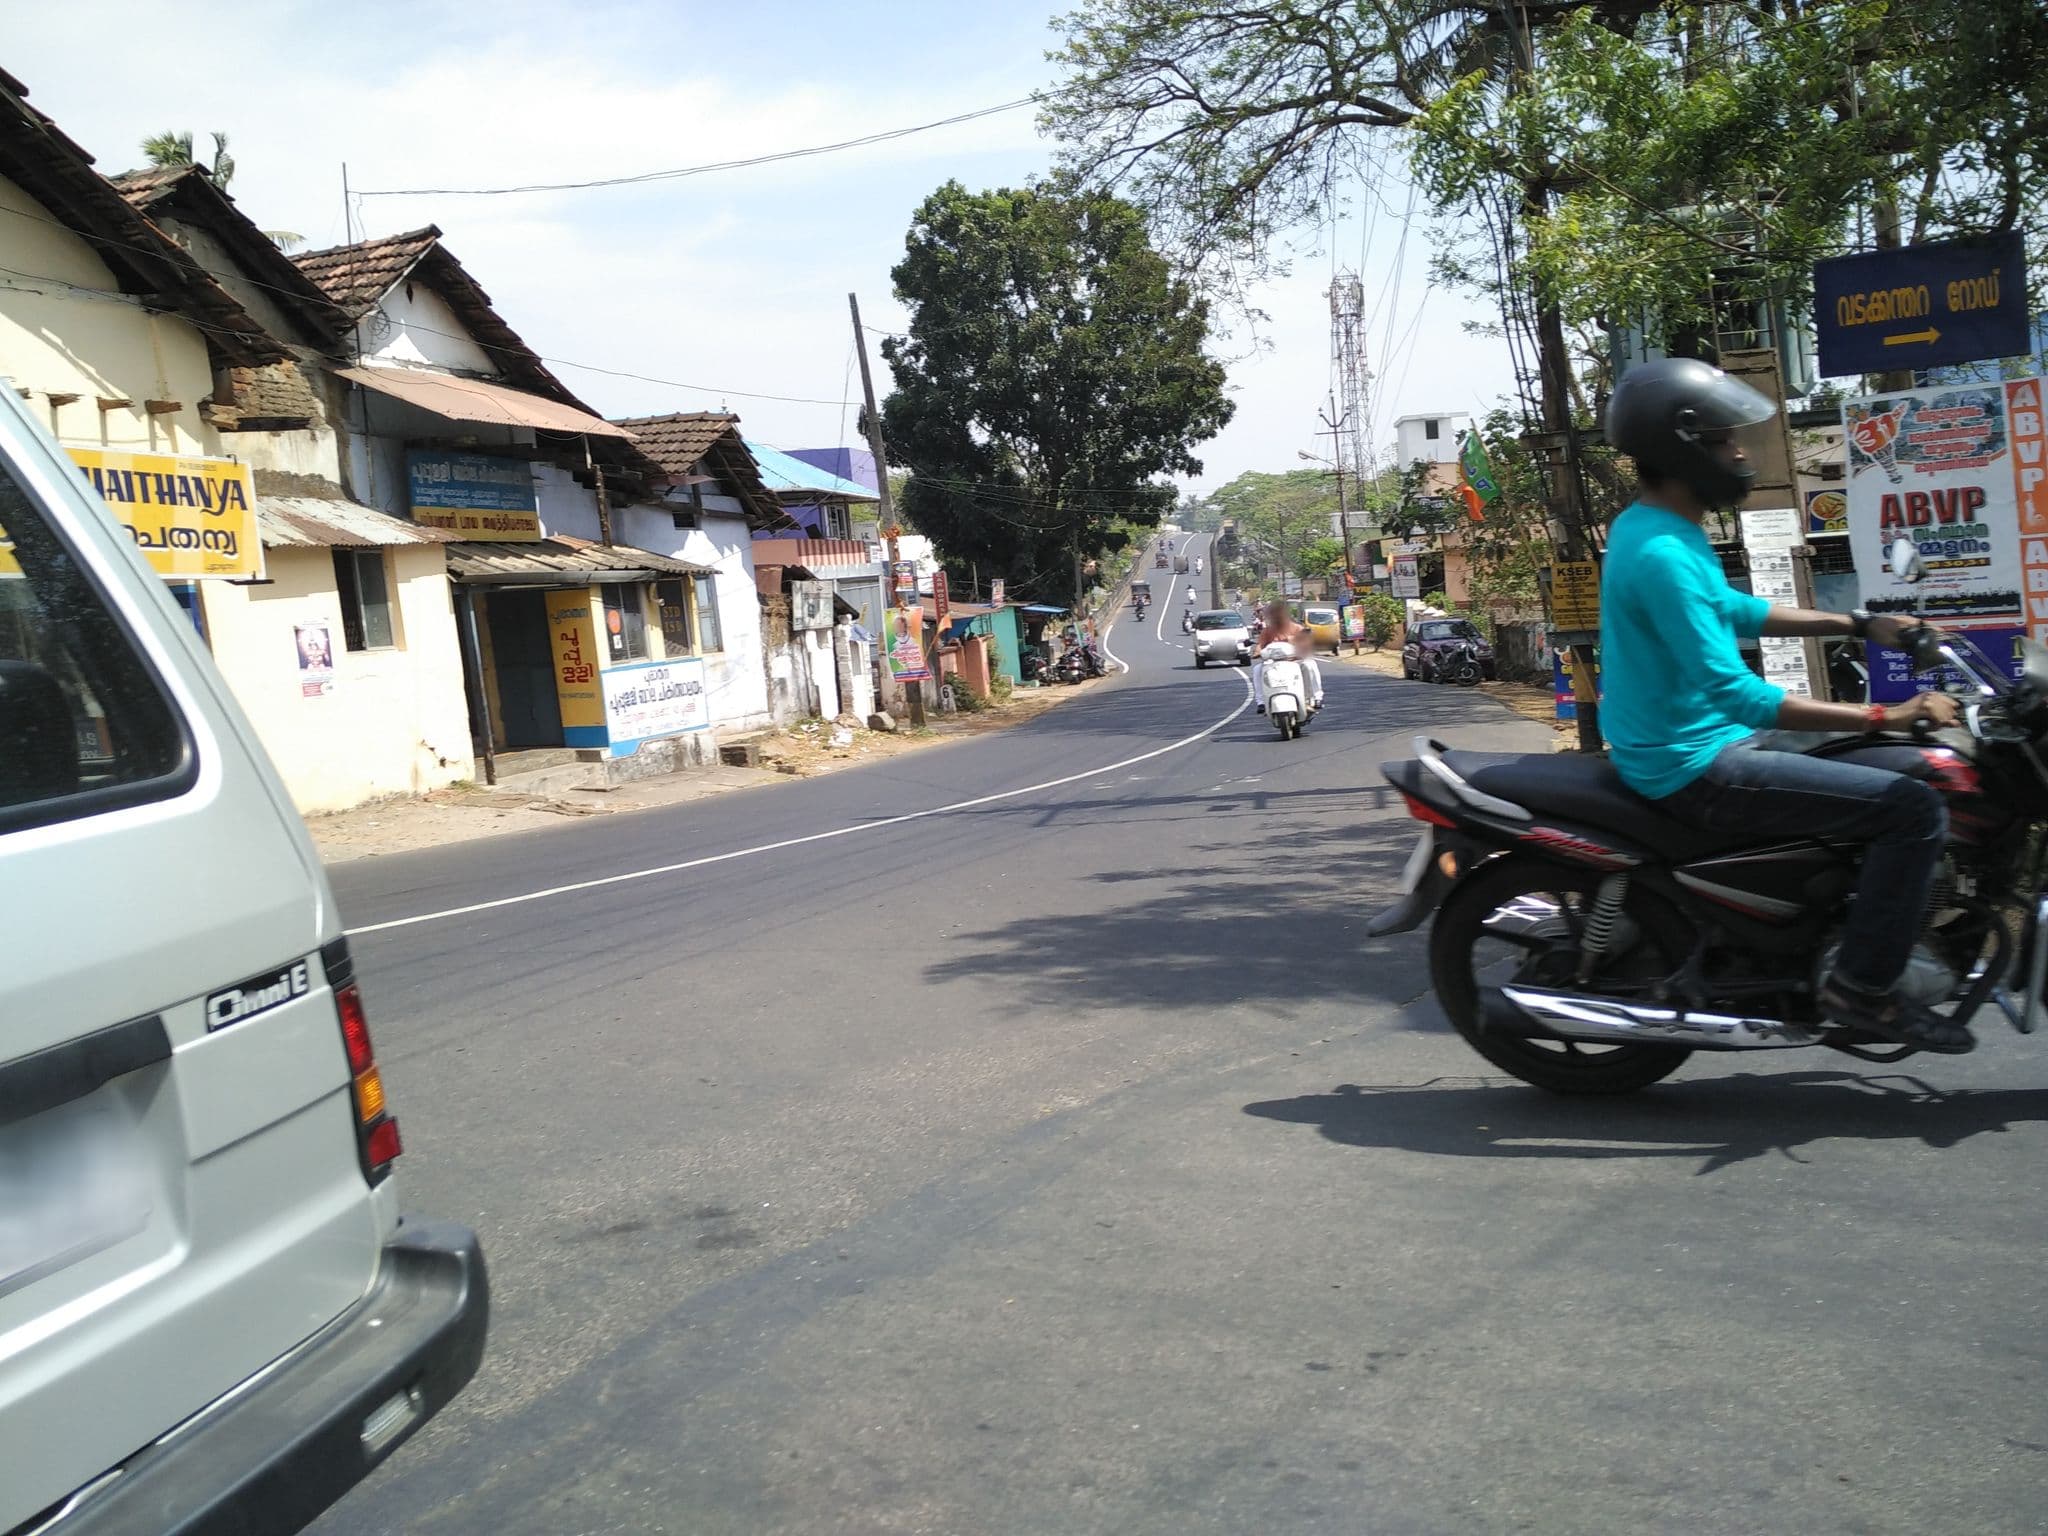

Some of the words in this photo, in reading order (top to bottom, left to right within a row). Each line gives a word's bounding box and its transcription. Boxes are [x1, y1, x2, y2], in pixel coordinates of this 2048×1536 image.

[78, 466, 248, 516] HAITHANYA
[1880, 486, 1986, 529] ABVP
[1556, 566, 1593, 577] KSEB
[942, 686, 950, 699] 6
